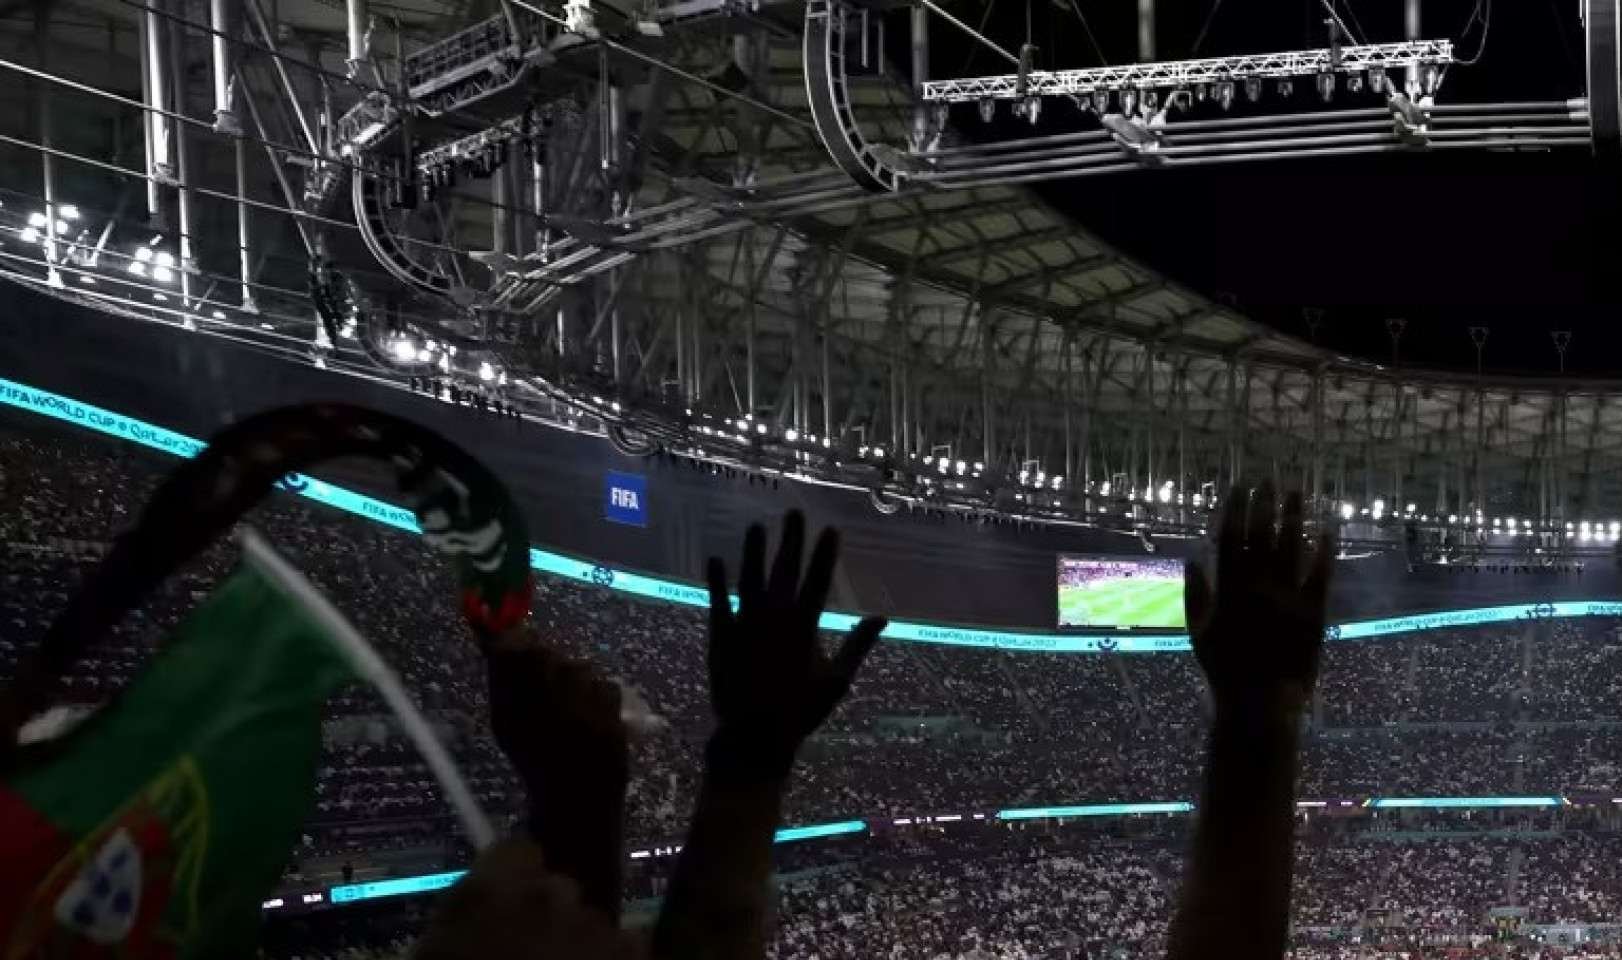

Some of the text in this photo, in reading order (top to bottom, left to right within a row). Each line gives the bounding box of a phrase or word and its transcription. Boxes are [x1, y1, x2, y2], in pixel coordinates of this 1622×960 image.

[32, 395, 85, 419] WORLD
[88, 413, 115, 427] CUP
[611, 487, 639, 509] FIFA
